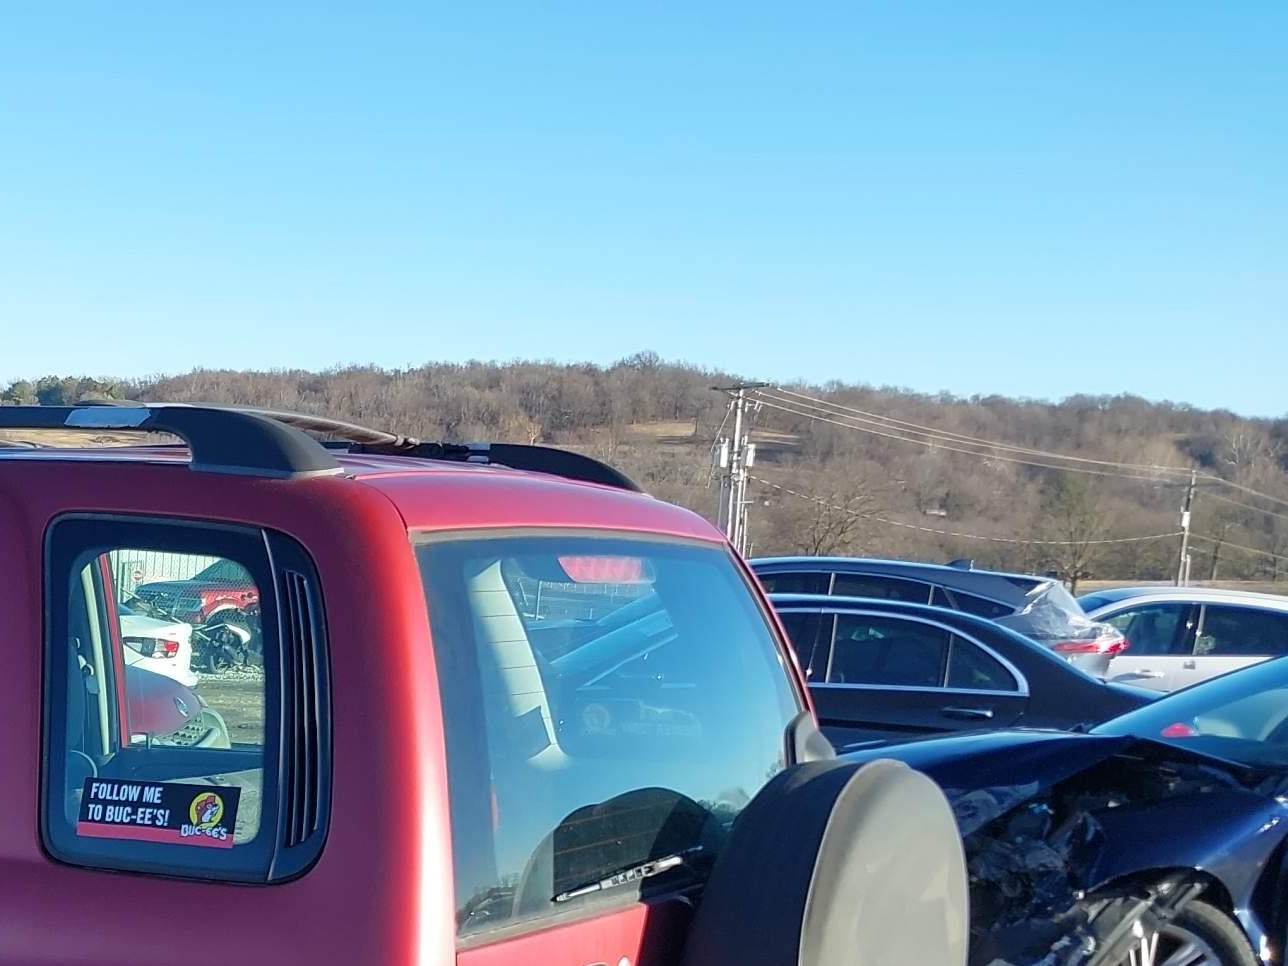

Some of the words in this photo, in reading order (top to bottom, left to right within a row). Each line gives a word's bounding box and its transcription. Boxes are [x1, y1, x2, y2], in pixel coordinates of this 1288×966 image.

[90, 782, 142, 802] FOLLOW
[142, 786, 164, 804] ME
[87, 804, 103, 821] TO
[105, 806, 170, 826] BUC-EE'S!
